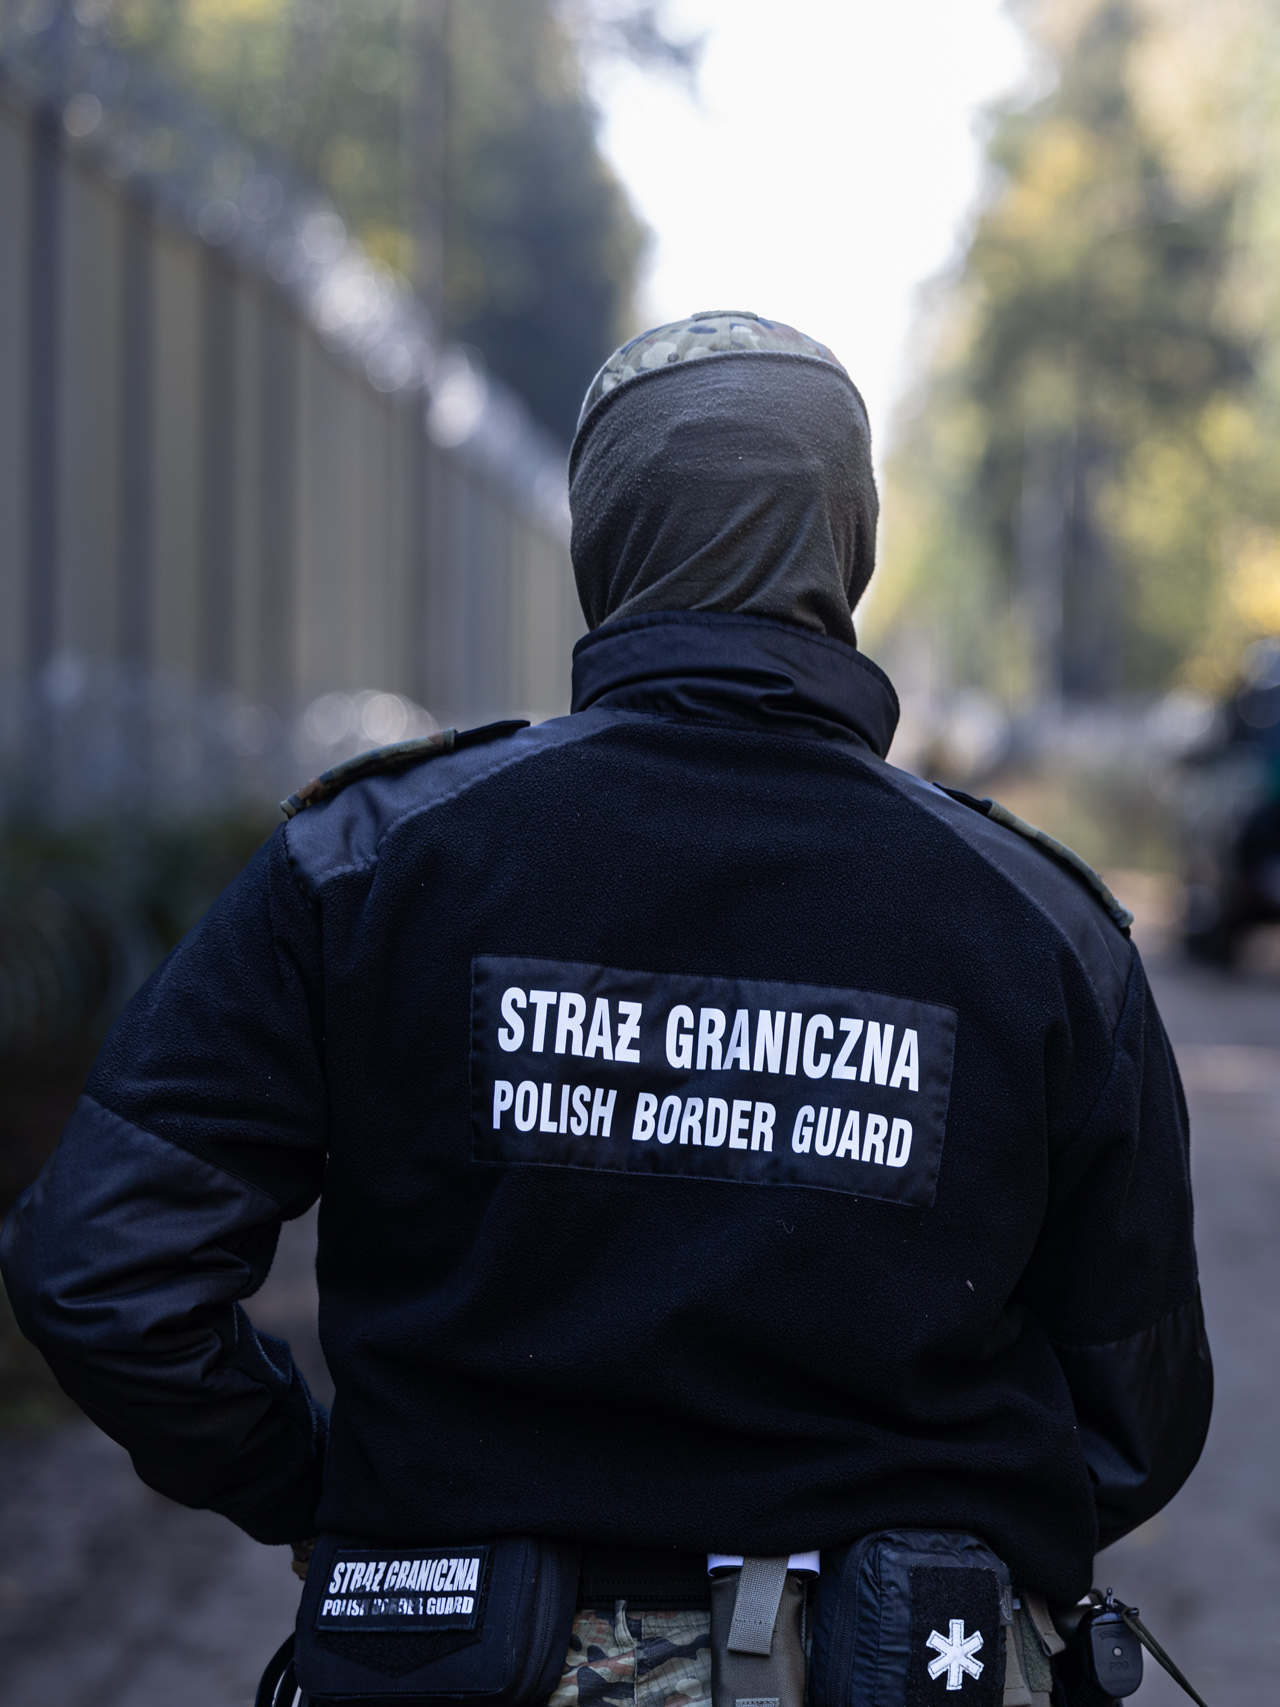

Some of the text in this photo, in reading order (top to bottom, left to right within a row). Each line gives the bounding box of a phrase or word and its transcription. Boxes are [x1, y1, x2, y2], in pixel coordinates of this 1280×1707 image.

[666, 1005, 919, 1092] GRANICZNA
[493, 1080, 912, 1167] POLISH BORDER GUARD
[384, 1558, 479, 1591] GRANICZNA
[426, 1596, 474, 1616] GUARD
